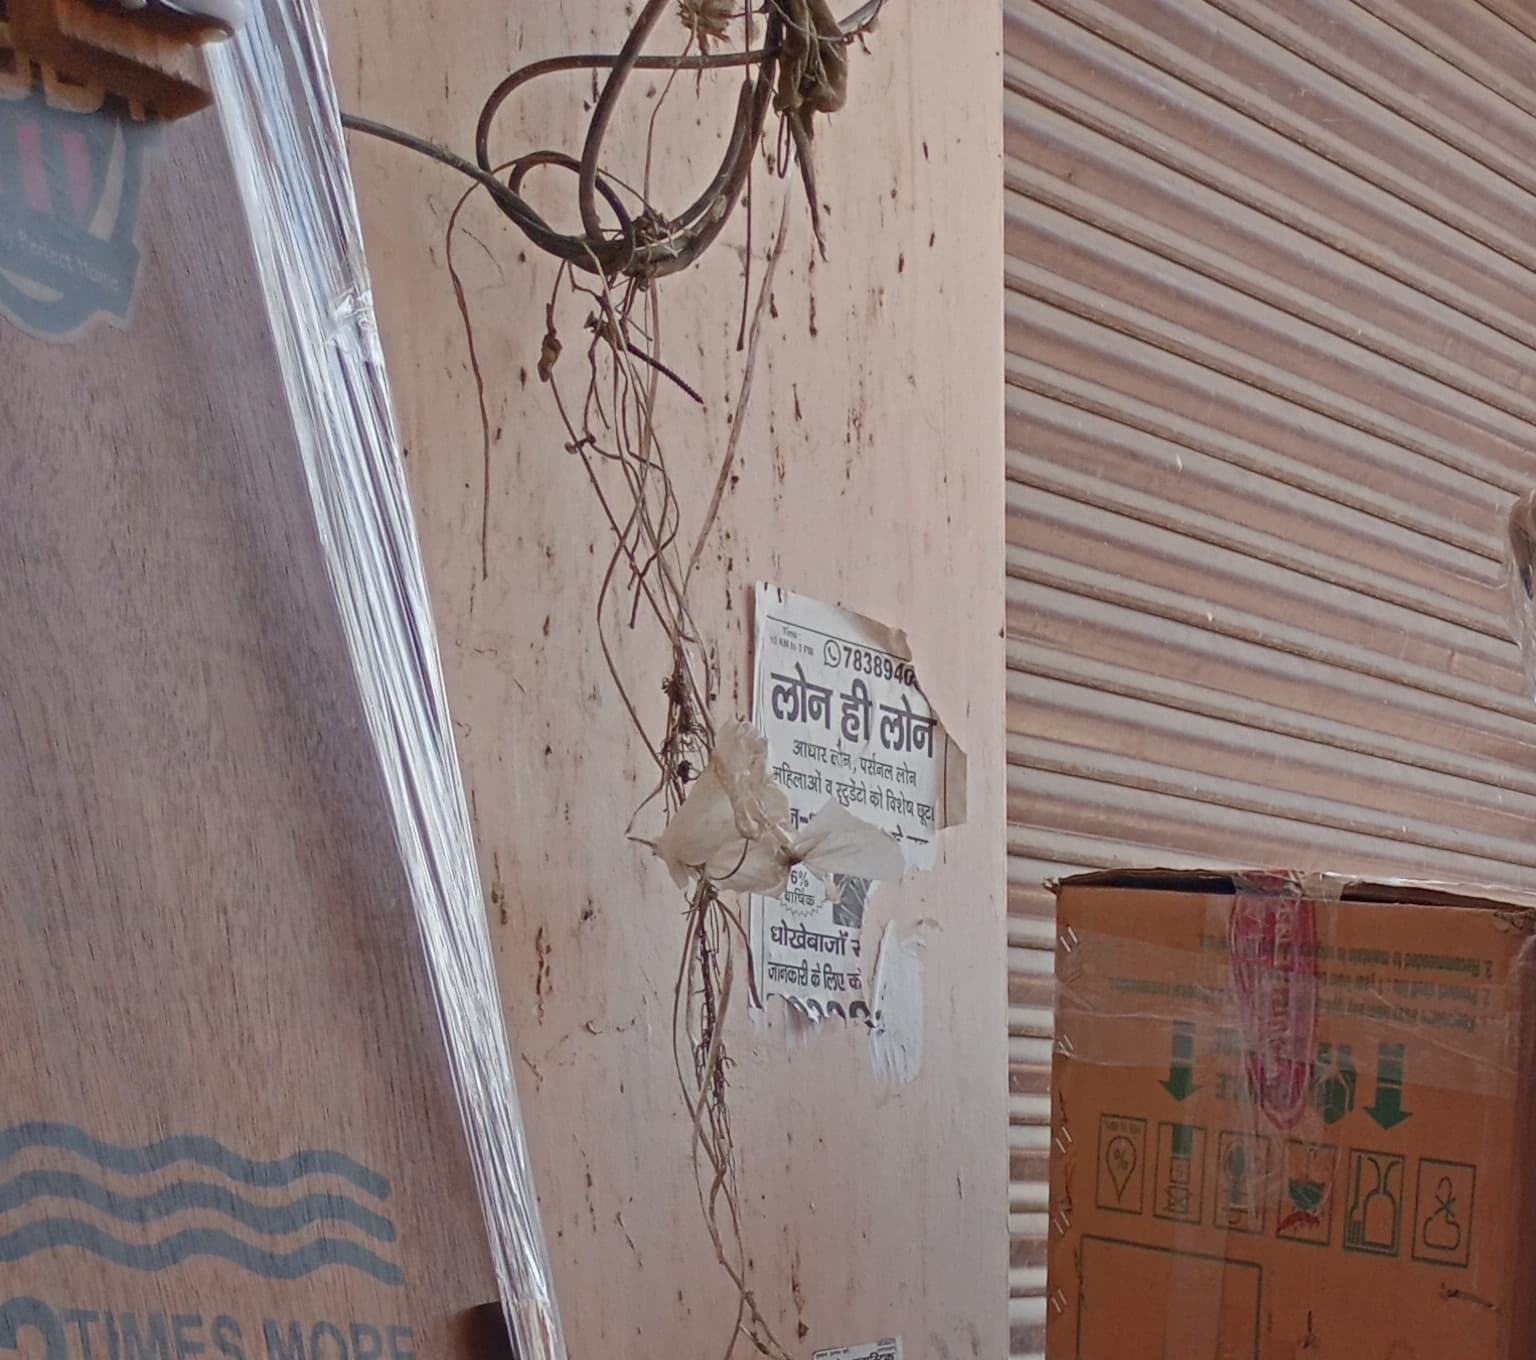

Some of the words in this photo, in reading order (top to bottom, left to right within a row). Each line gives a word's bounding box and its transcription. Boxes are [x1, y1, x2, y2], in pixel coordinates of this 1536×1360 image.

[842, 646, 916, 687] 7838940
[770, 661, 833, 730] लोन
[840, 678, 872, 743] ही
[879, 693, 938, 758] लोन
[792, 739, 827, 764] आधार
[895, 761, 917, 787] लोन
[824, 779, 833, 796] व
[869, 785, 883, 809] को
[886, 788, 914, 816] विशेष
[767, 959, 809, 986] जानकारी
[810, 962, 821, 988] के
[823, 963, 846, 991] लिए
